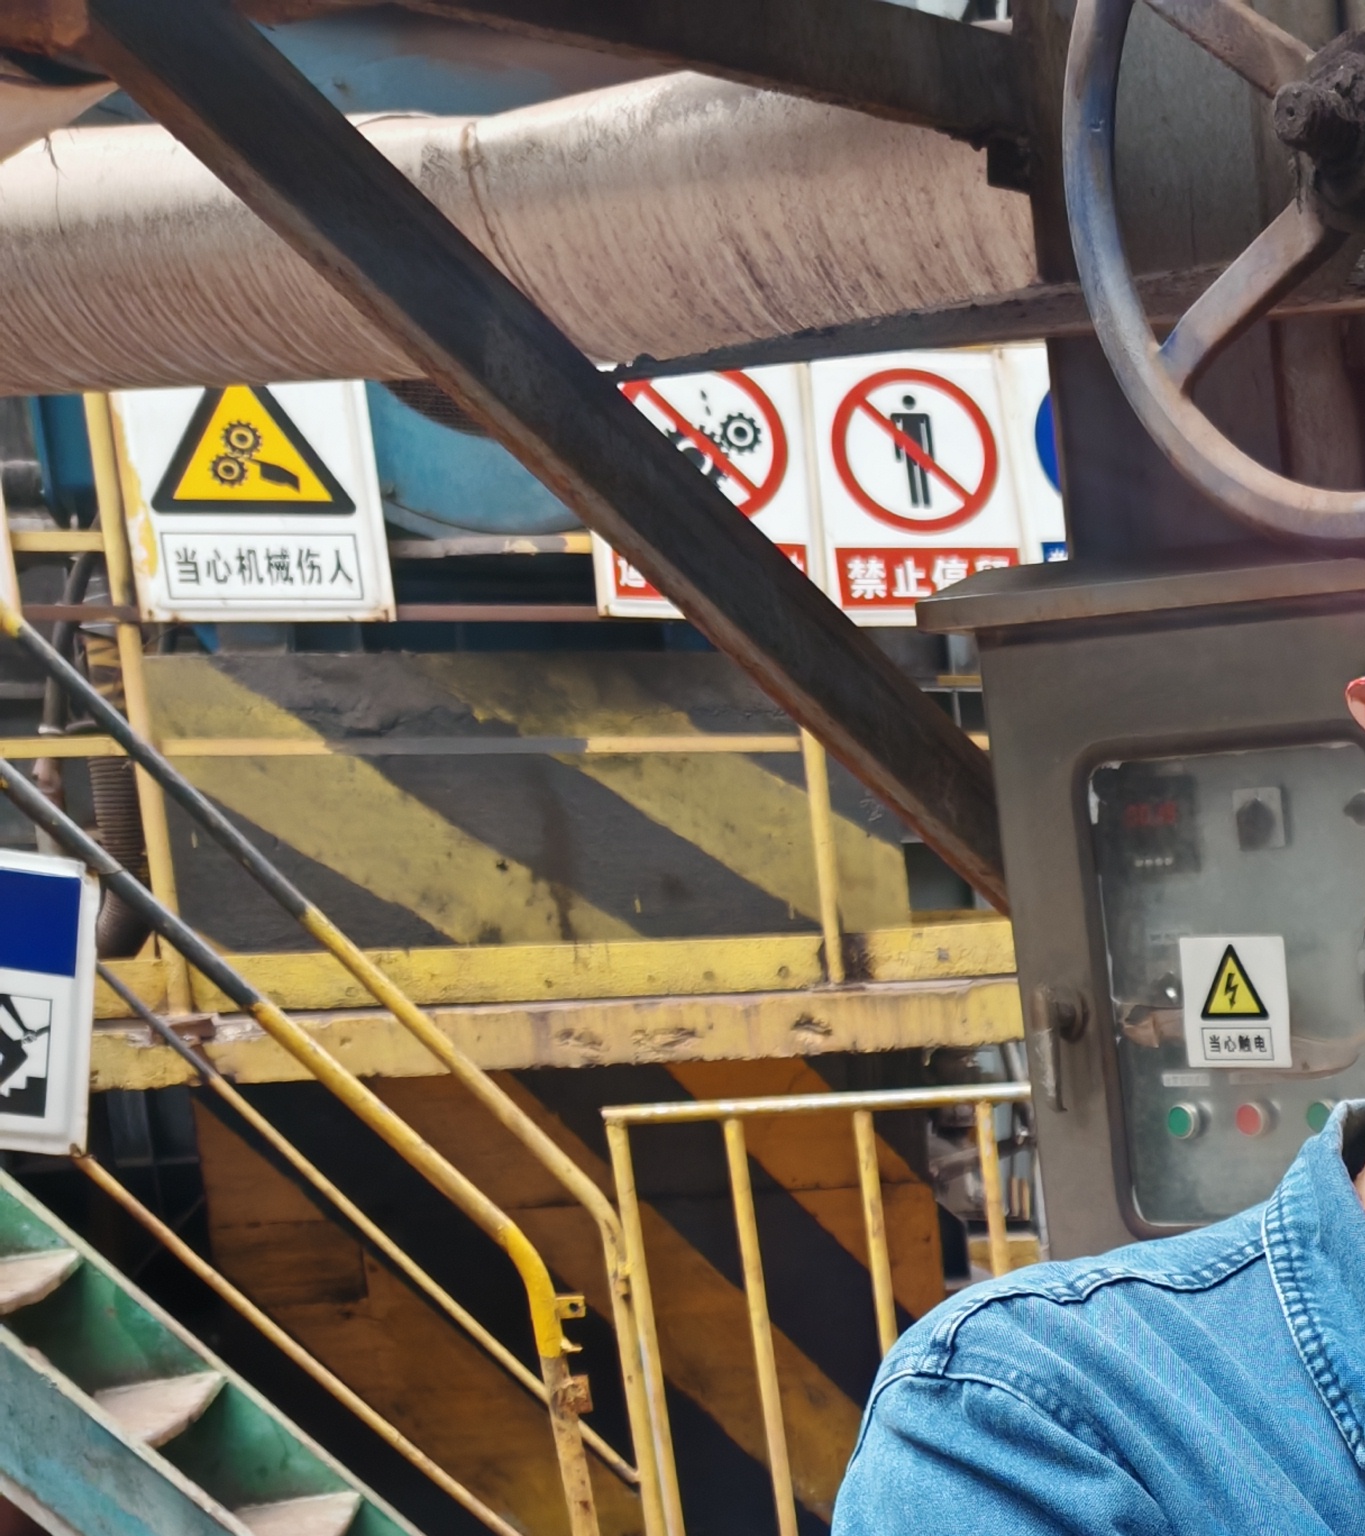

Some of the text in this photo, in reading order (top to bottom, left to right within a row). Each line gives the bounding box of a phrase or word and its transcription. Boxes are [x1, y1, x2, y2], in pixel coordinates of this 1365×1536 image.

[174, 546, 354, 586] 当心机械伤人
[1208, 1034, 1268, 1053] 当心触电
